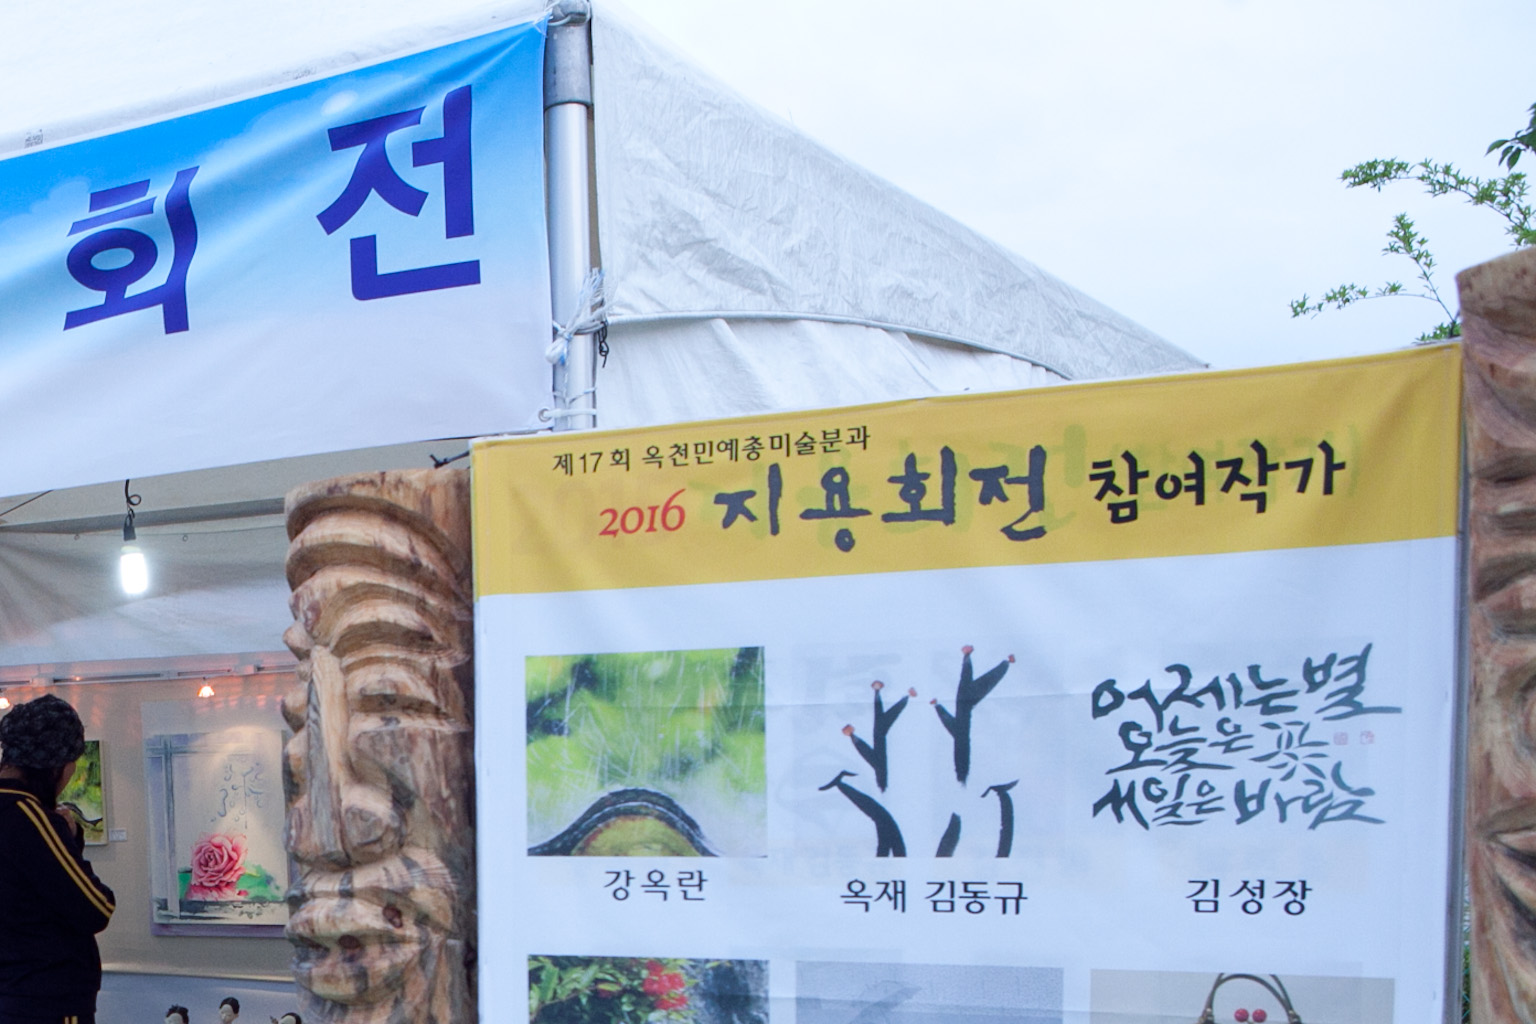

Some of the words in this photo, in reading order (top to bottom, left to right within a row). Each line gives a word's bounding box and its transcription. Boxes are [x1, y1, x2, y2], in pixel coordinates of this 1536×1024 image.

[552, 448, 630, 477] 제17회
[641, 425, 871, 467] 옥천민예총미술분과
[599, 488, 686, 538] 2016
[712, 444, 1049, 554] 지용회전
[1088, 439, 1347, 525] 참여작가
[1091, 662, 1302, 734] 어제는
[1302, 641, 1403, 722] 별
[1104, 715, 1255, 776] 오늘은
[1234, 759, 1387, 831] 바람
[605, 868, 708, 901] 강옥란
[840, 879, 907, 914] 옥재
[925, 880, 1029, 916] 김동규
[1185, 878, 1313, 916] 김성장
